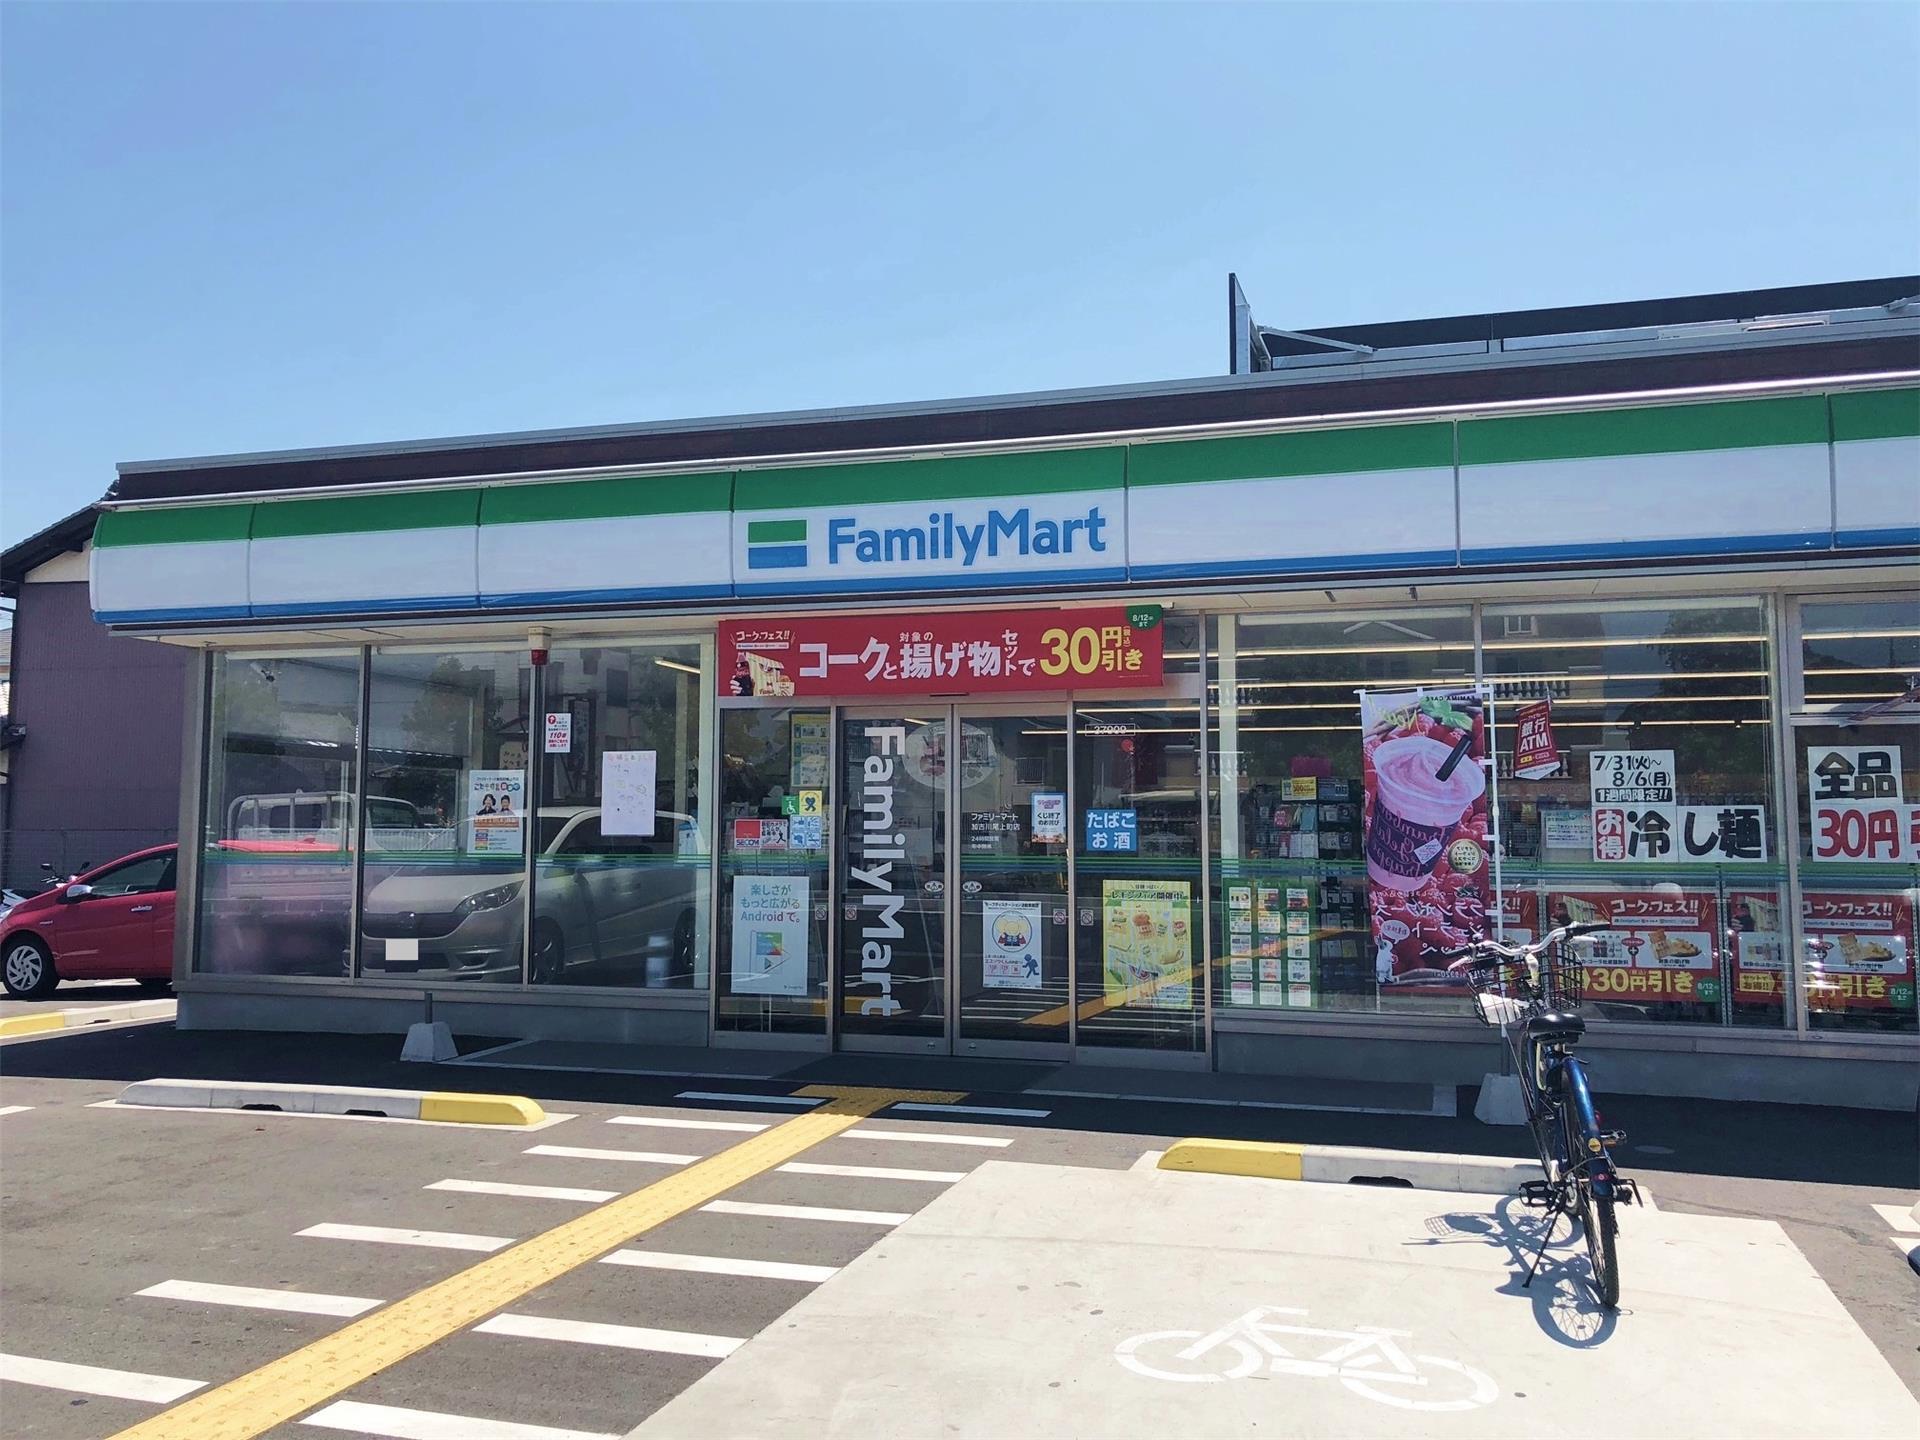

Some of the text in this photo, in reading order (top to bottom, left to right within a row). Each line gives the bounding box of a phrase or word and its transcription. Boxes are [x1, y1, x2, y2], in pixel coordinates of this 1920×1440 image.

[828, 506, 1106, 566] FamilyMart
[900, 631, 933, 643] 対象の
[1521, 717, 1546, 738] 銀行
[1519, 732, 1549, 753] ATM
[1612, 771, 1671, 787] 8/6(月)
[1814, 751, 1898, 801] 全品
[1597, 788, 1669, 802] 1週間限定!!
[971, 812, 1019, 821] ファミリーマート
[1087, 811, 1136, 829] たばこ
[1092, 831, 1131, 849] お酒
[1597, 810, 1624, 860] お得
[1817, 808, 1920, 859] 30円
[736, 839, 760, 847] SECOM
[851, 726, 906, 1016] FamilyMart
[751, 883, 792, 896] 楽しさが
[740, 897, 801, 909] もっと広がる
[1610, 899, 1699, 914] コーク・フェス!!
[740, 911, 784, 922] Android
[1592, 968, 1694, 994] 30円引き
